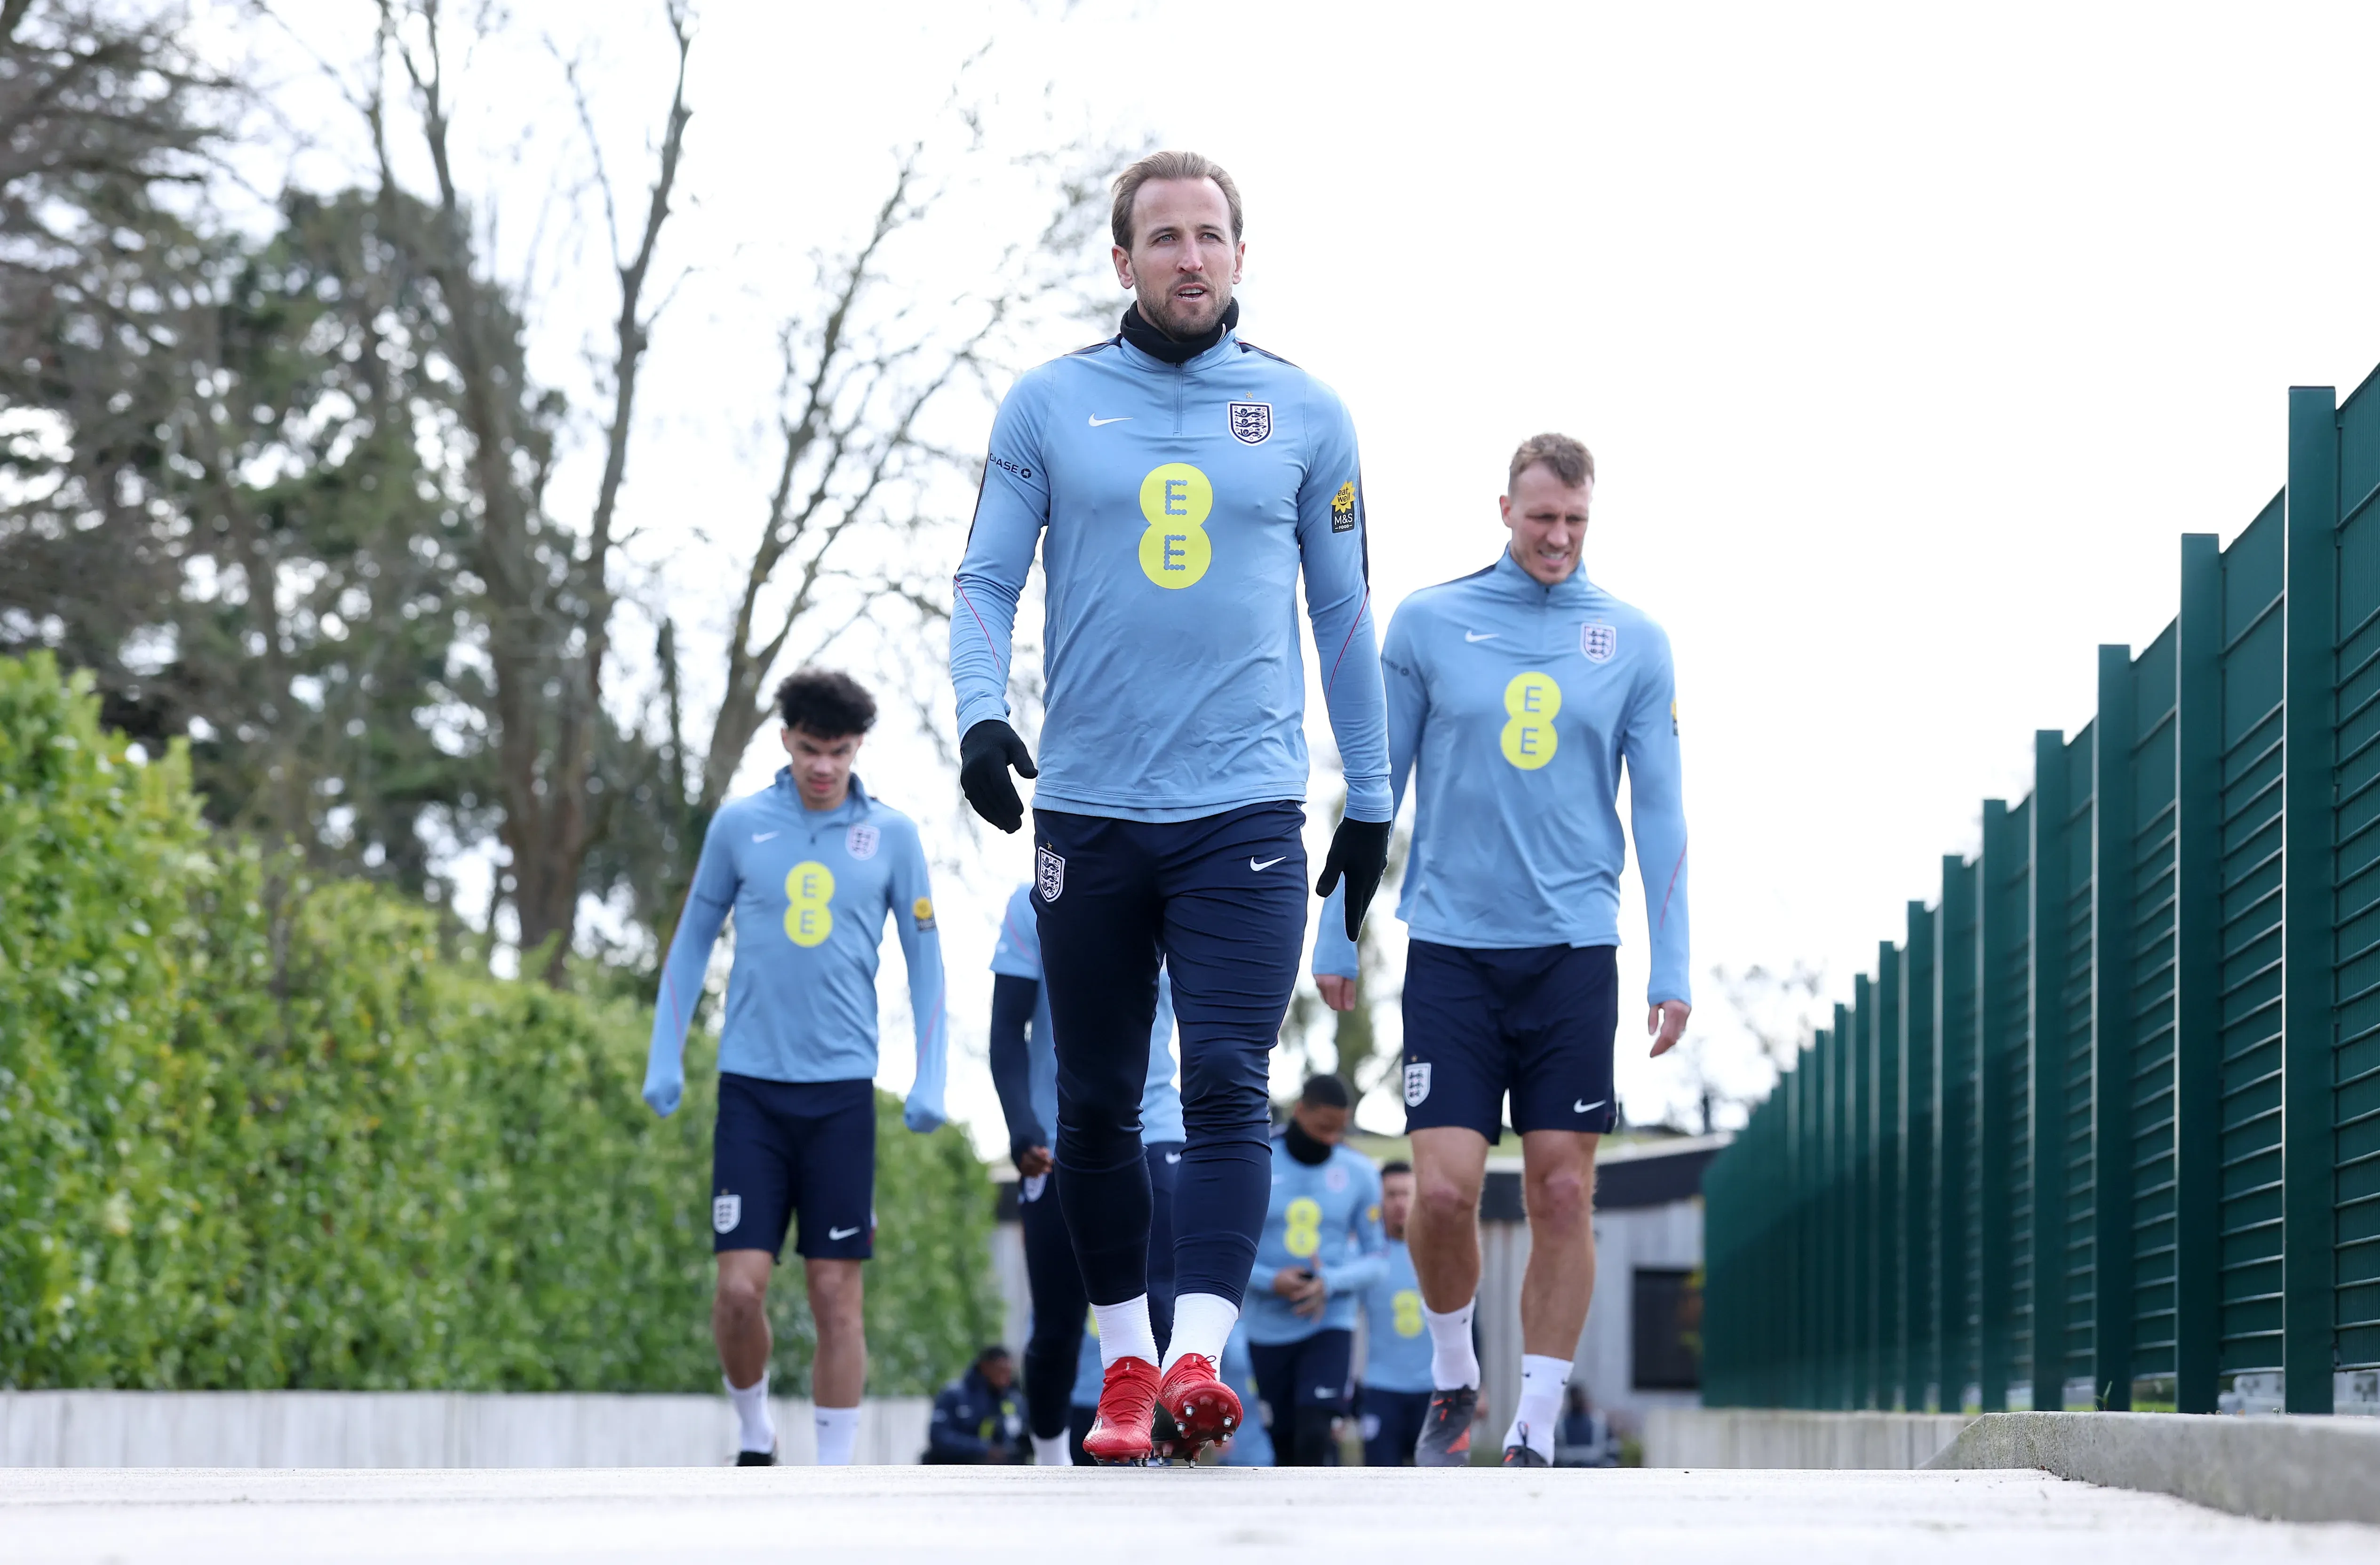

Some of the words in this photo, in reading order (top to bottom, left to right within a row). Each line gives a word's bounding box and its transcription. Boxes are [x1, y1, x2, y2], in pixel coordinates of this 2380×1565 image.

[1337, 487, 1349, 496] eat
[1337, 492, 1350, 503] well
[1335, 513, 1353, 525] M&S
